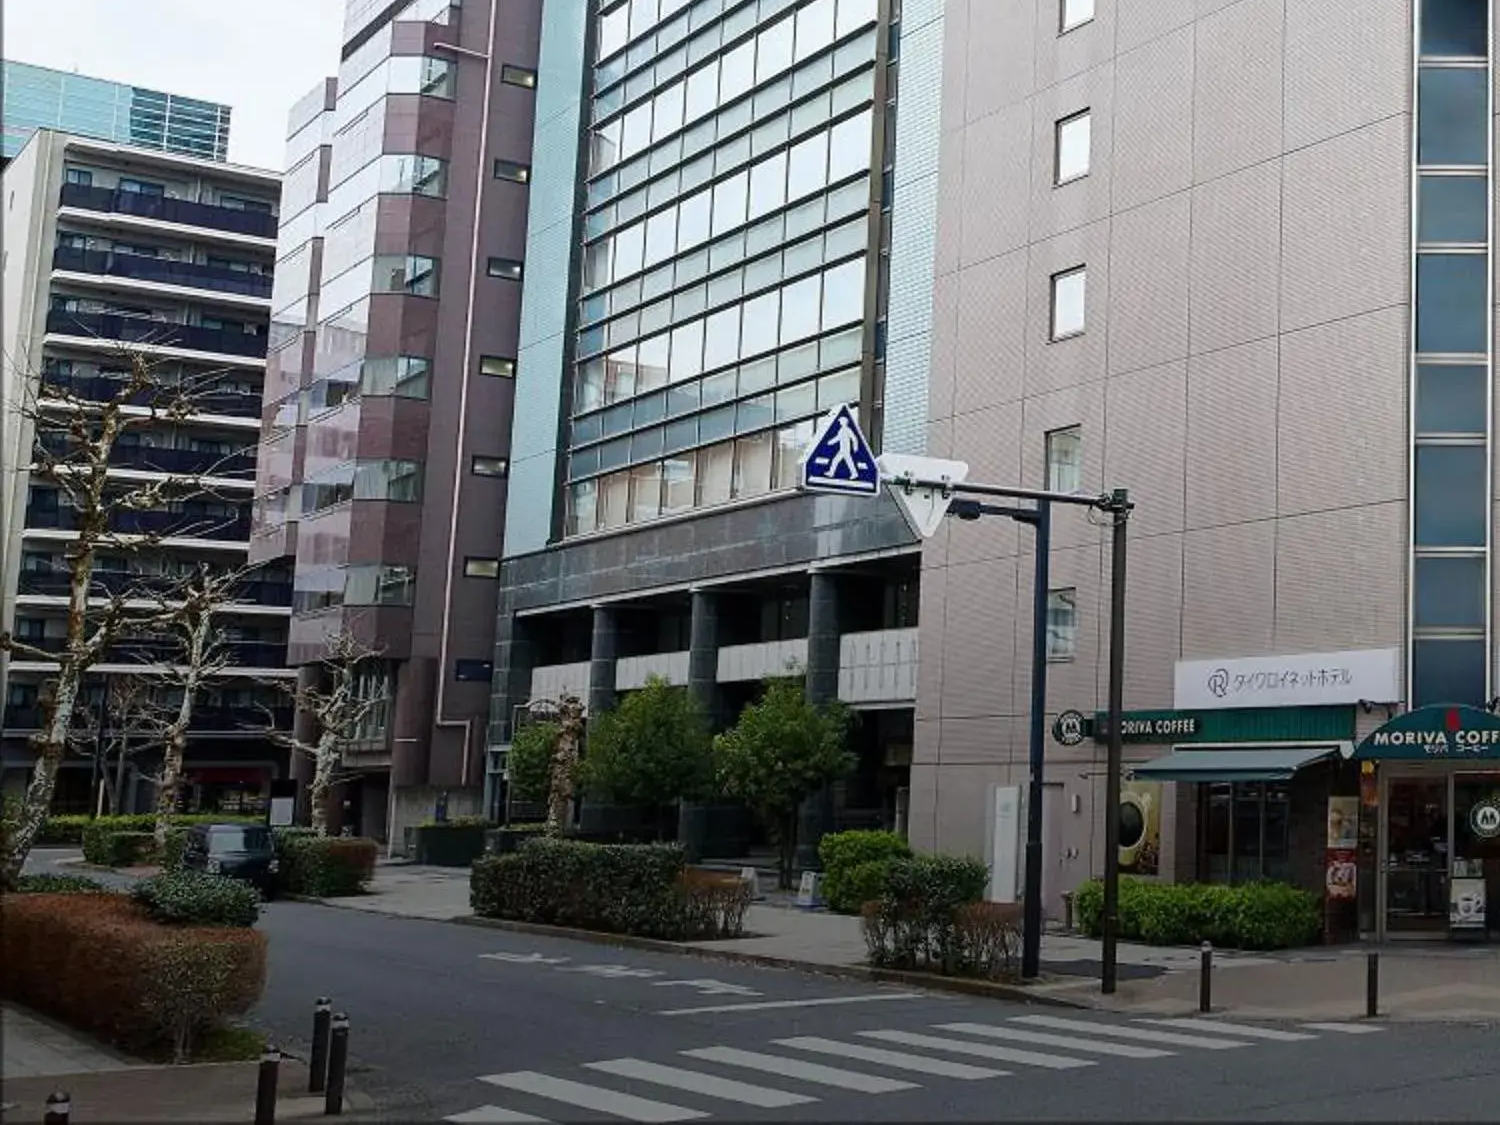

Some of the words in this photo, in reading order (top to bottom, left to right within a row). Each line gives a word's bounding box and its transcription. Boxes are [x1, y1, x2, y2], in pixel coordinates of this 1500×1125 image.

[1121, 720, 1153, 735] ORIVA
[1155, 718, 1195, 734] COFFEE
[1374, 731, 1447, 746] MORIVA
